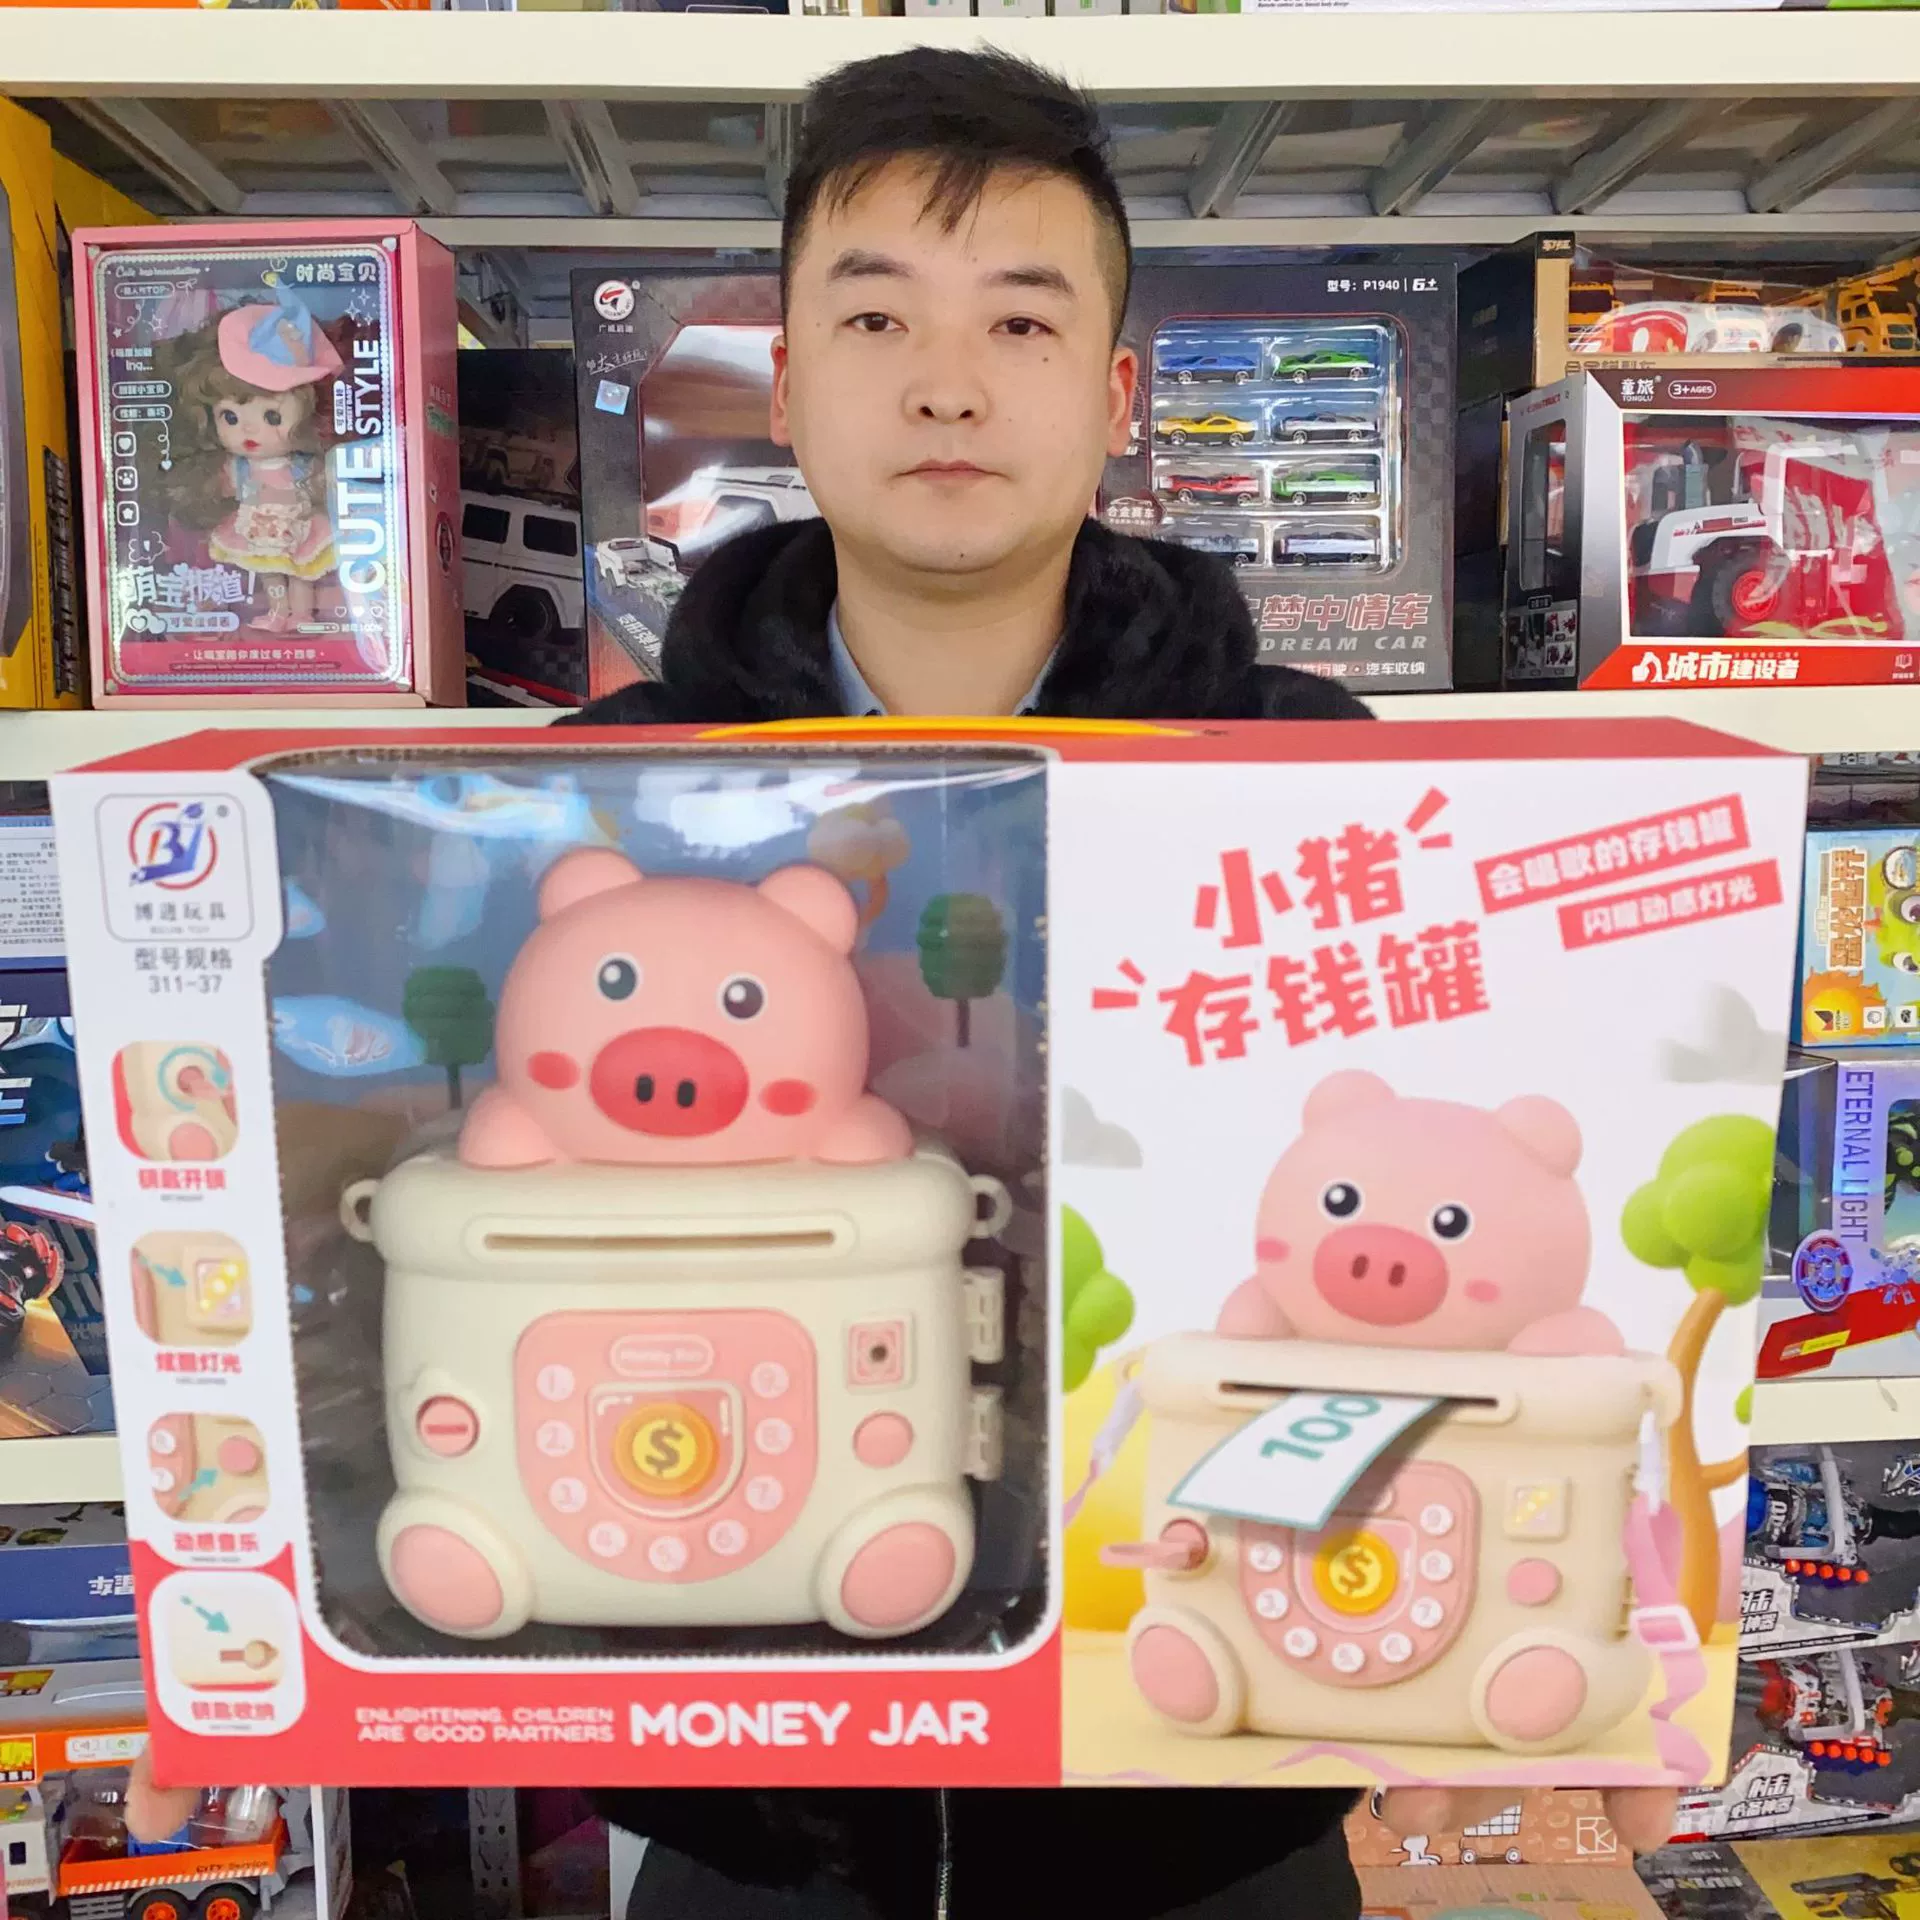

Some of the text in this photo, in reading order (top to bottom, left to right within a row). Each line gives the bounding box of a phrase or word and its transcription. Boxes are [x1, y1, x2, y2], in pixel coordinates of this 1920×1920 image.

[295, 262, 377, 283] 时尚宝贝
[1363, 280, 1400, 290] P1940
[353, 339, 383, 436] STYLE
[1620, 378, 1654, 395] 童旅
[336, 447, 386, 596] CUTE
[1245, 592, 1433, 632] 梦中情车
[1260, 635, 1428, 651] DREAM CAR
[1665, 651, 1801, 681] 城市建设者
[1488, 806, 1737, 901] 会唱歌的存钱罐
[1193, 823, 1405, 949] 小猪
[1580, 873, 1759, 939] 闪耀动感灯光
[134, 946, 233, 972] 型号规格
[148, 974, 224, 995] 311-37
[1157, 919, 1491, 1067] 存钱罐
[1840, 1069, 1875, 1173] ETERNAL
[1840, 1178, 1869, 1243] LIGHT
[1260, 1395, 1382, 1462] 100
[357, 1725, 615, 1744] ARE GOOD PARTNERS
[512, 1706, 615, 1724] CHILDREN
[629, 1701, 990, 1747] MONEY JAR
